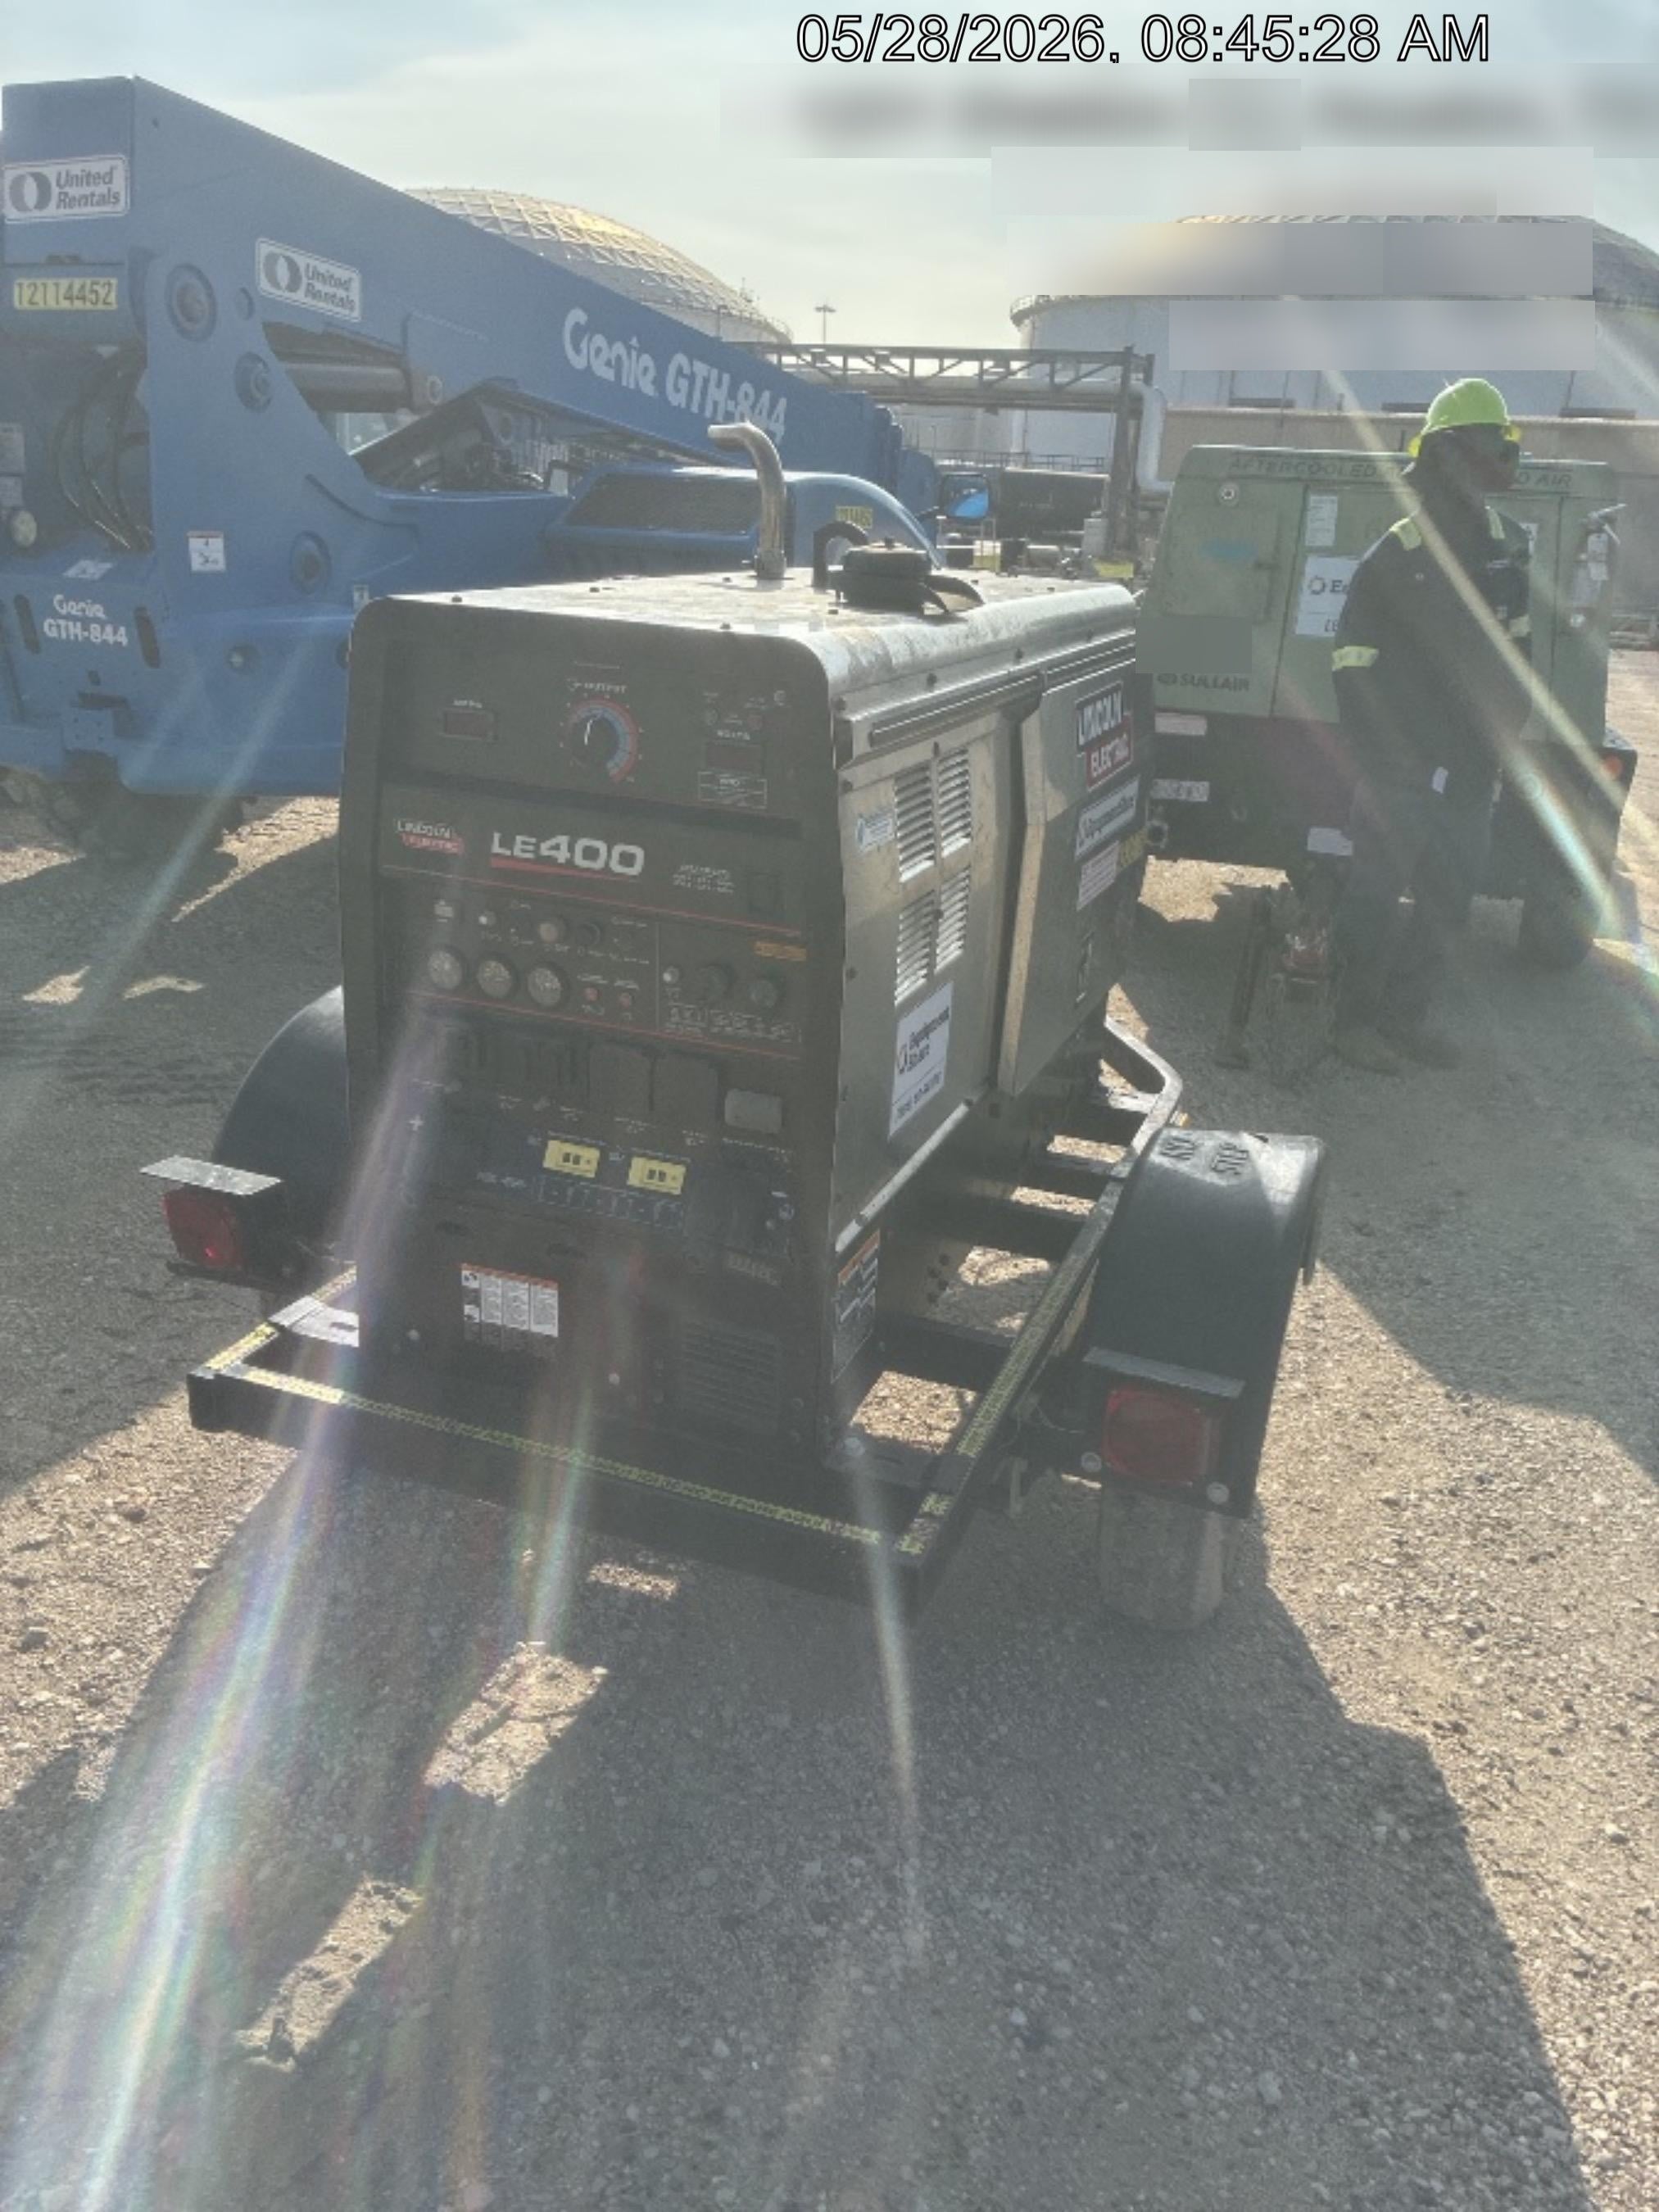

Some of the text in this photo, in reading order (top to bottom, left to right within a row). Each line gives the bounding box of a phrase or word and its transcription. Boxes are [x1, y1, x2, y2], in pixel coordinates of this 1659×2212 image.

[56, 165, 116, 189] United
[56, 188, 120, 211] Rentals
[304, 262, 353, 292] United
[16, 279, 114, 306] 12114452
[304, 283, 356, 313] Rentals
[562, 306, 787, 445] Genie GTH-844
[53, 594, 107, 620] Genie
[43, 619, 129, 647] GTH-844
[1179, 673, 1250, 692] SULLAIR
[1078, 690, 1122, 746] LINCOLN
[489, 830, 646, 877] LE400
